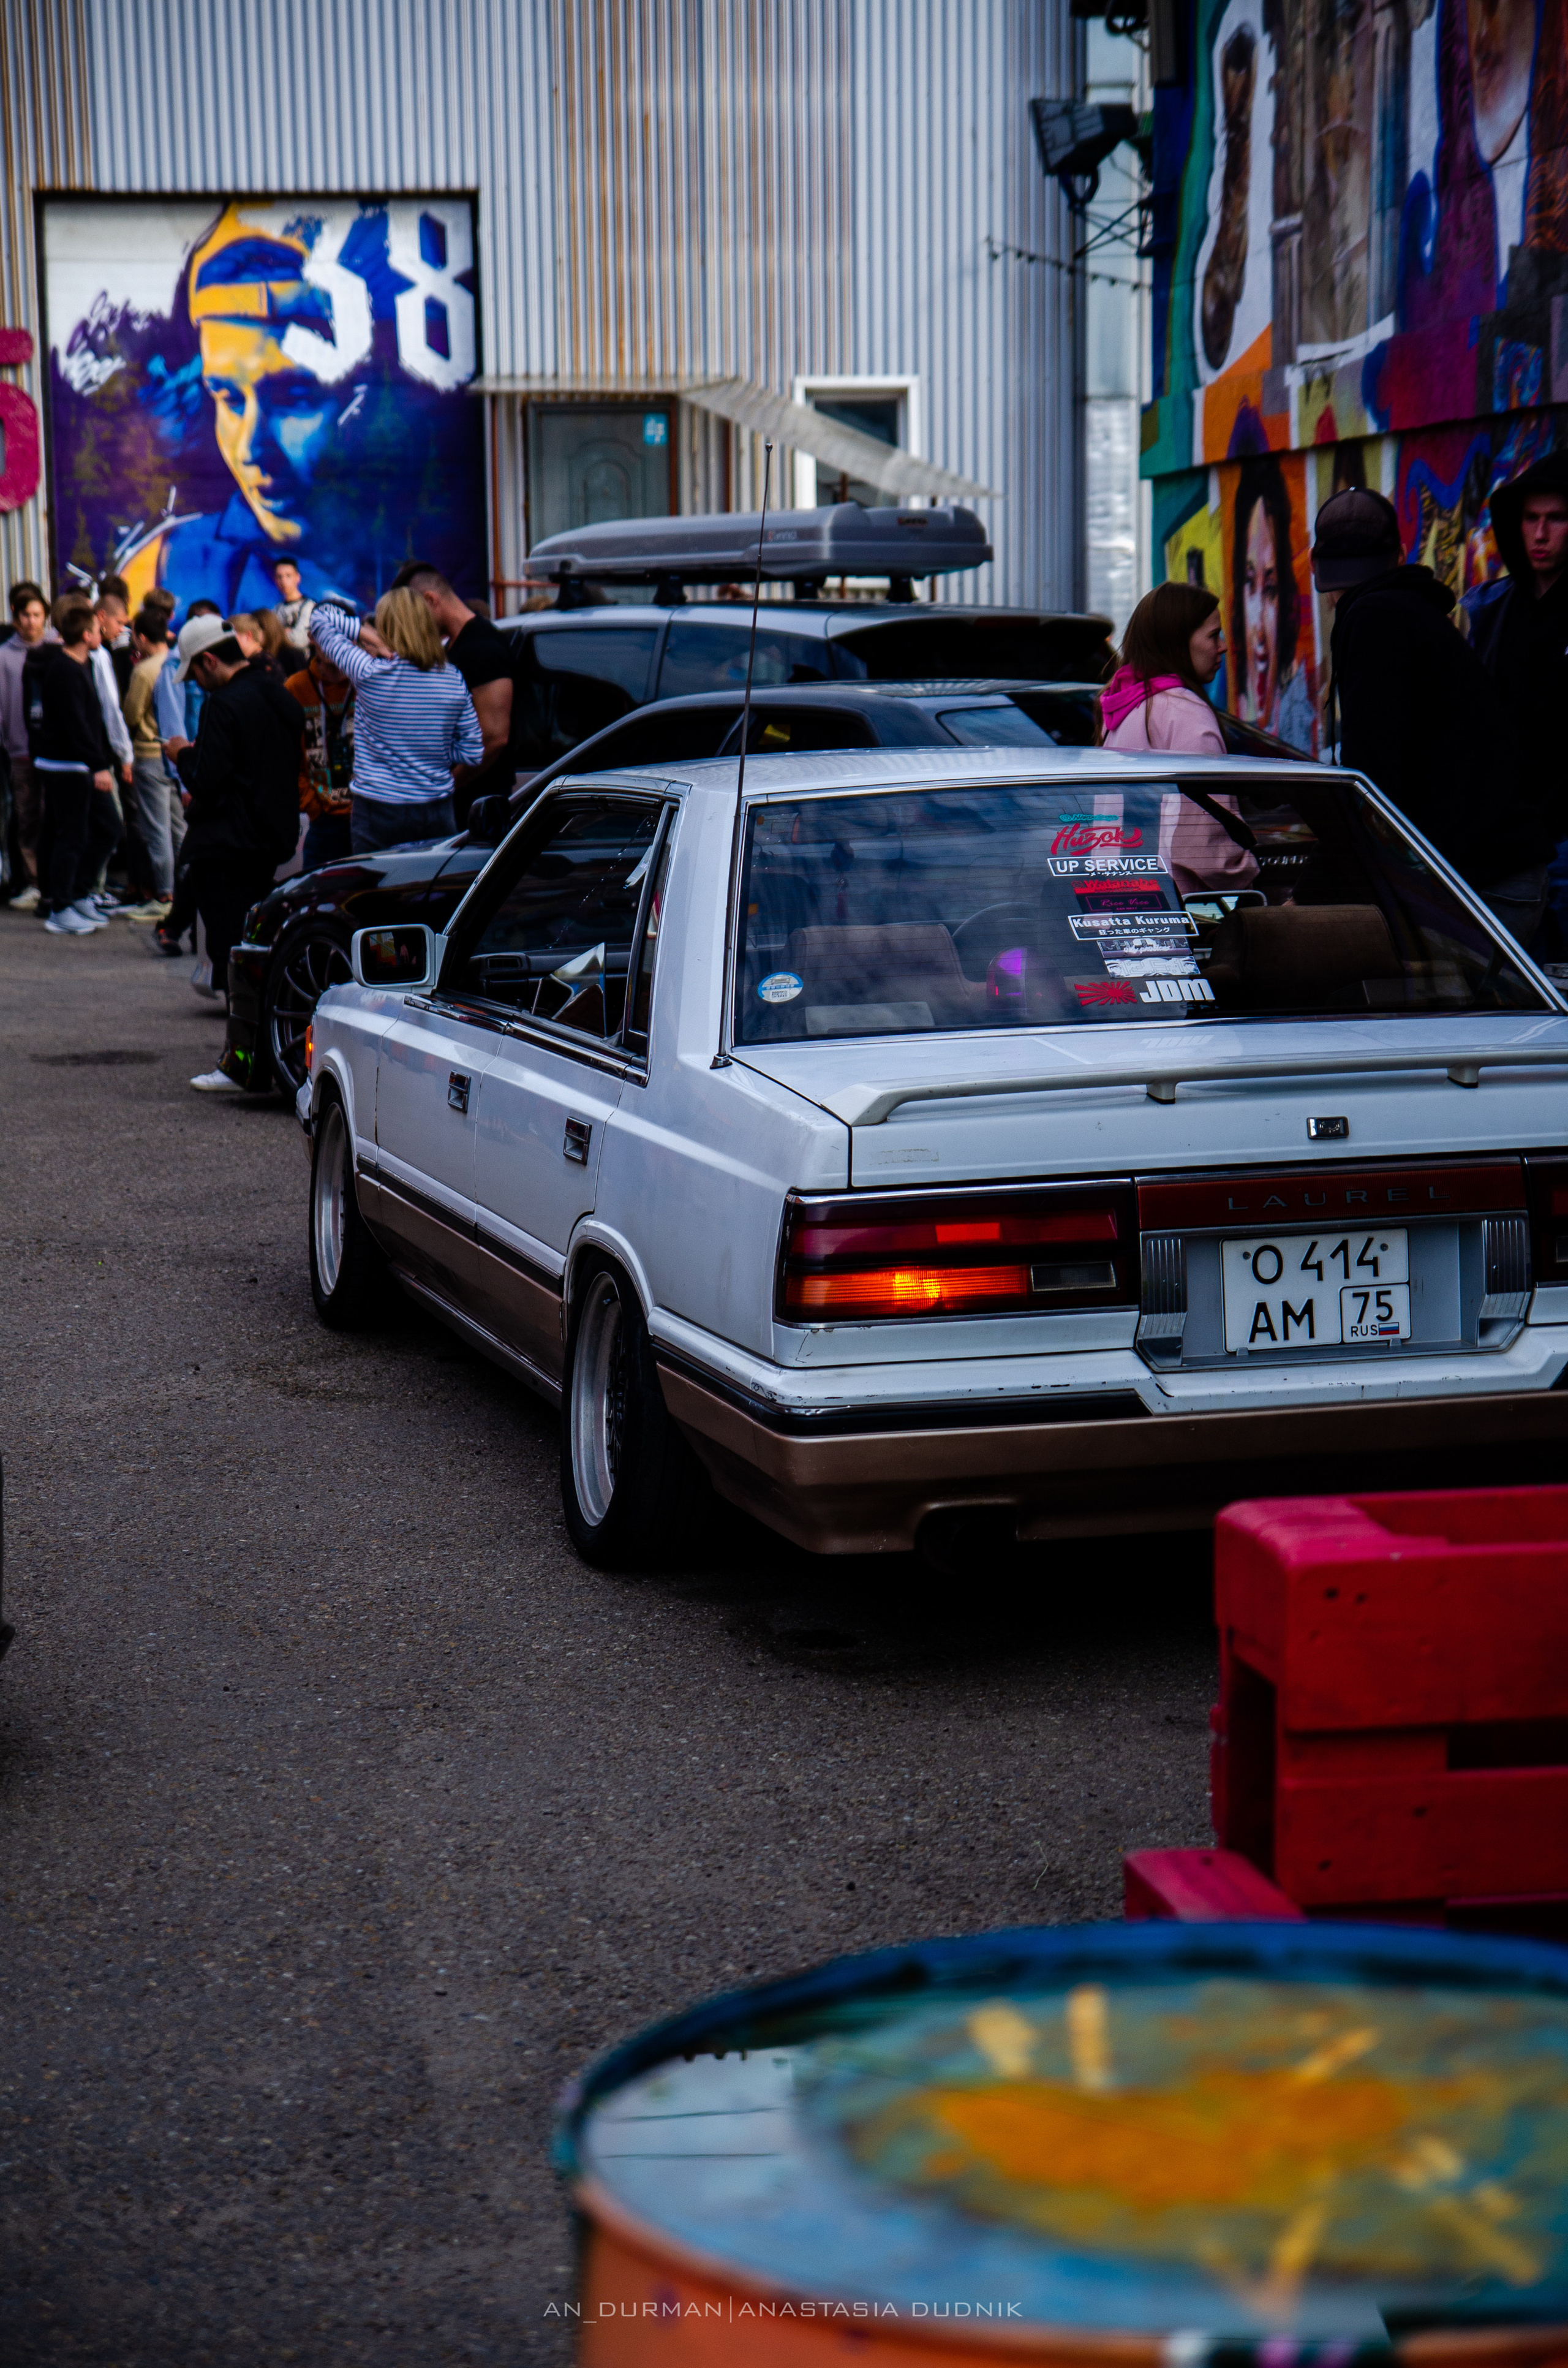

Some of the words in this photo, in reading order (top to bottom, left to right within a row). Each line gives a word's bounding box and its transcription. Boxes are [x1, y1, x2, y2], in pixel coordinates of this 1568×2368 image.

[1056, 860, 1079, 872] UP
[1084, 858, 1158, 871] SERVICE
[1072, 918, 1131, 928] Kusatta
[1134, 915, 1190, 926] Kuruma
[1139, 978, 1216, 1003] JDM
[1227, 1186, 1452, 1211] LAUREL
[1300, 1236, 1380, 1282] 414
[1352, 1290, 1394, 1324] 75
[1351, 1324, 1379, 1337] RUS
